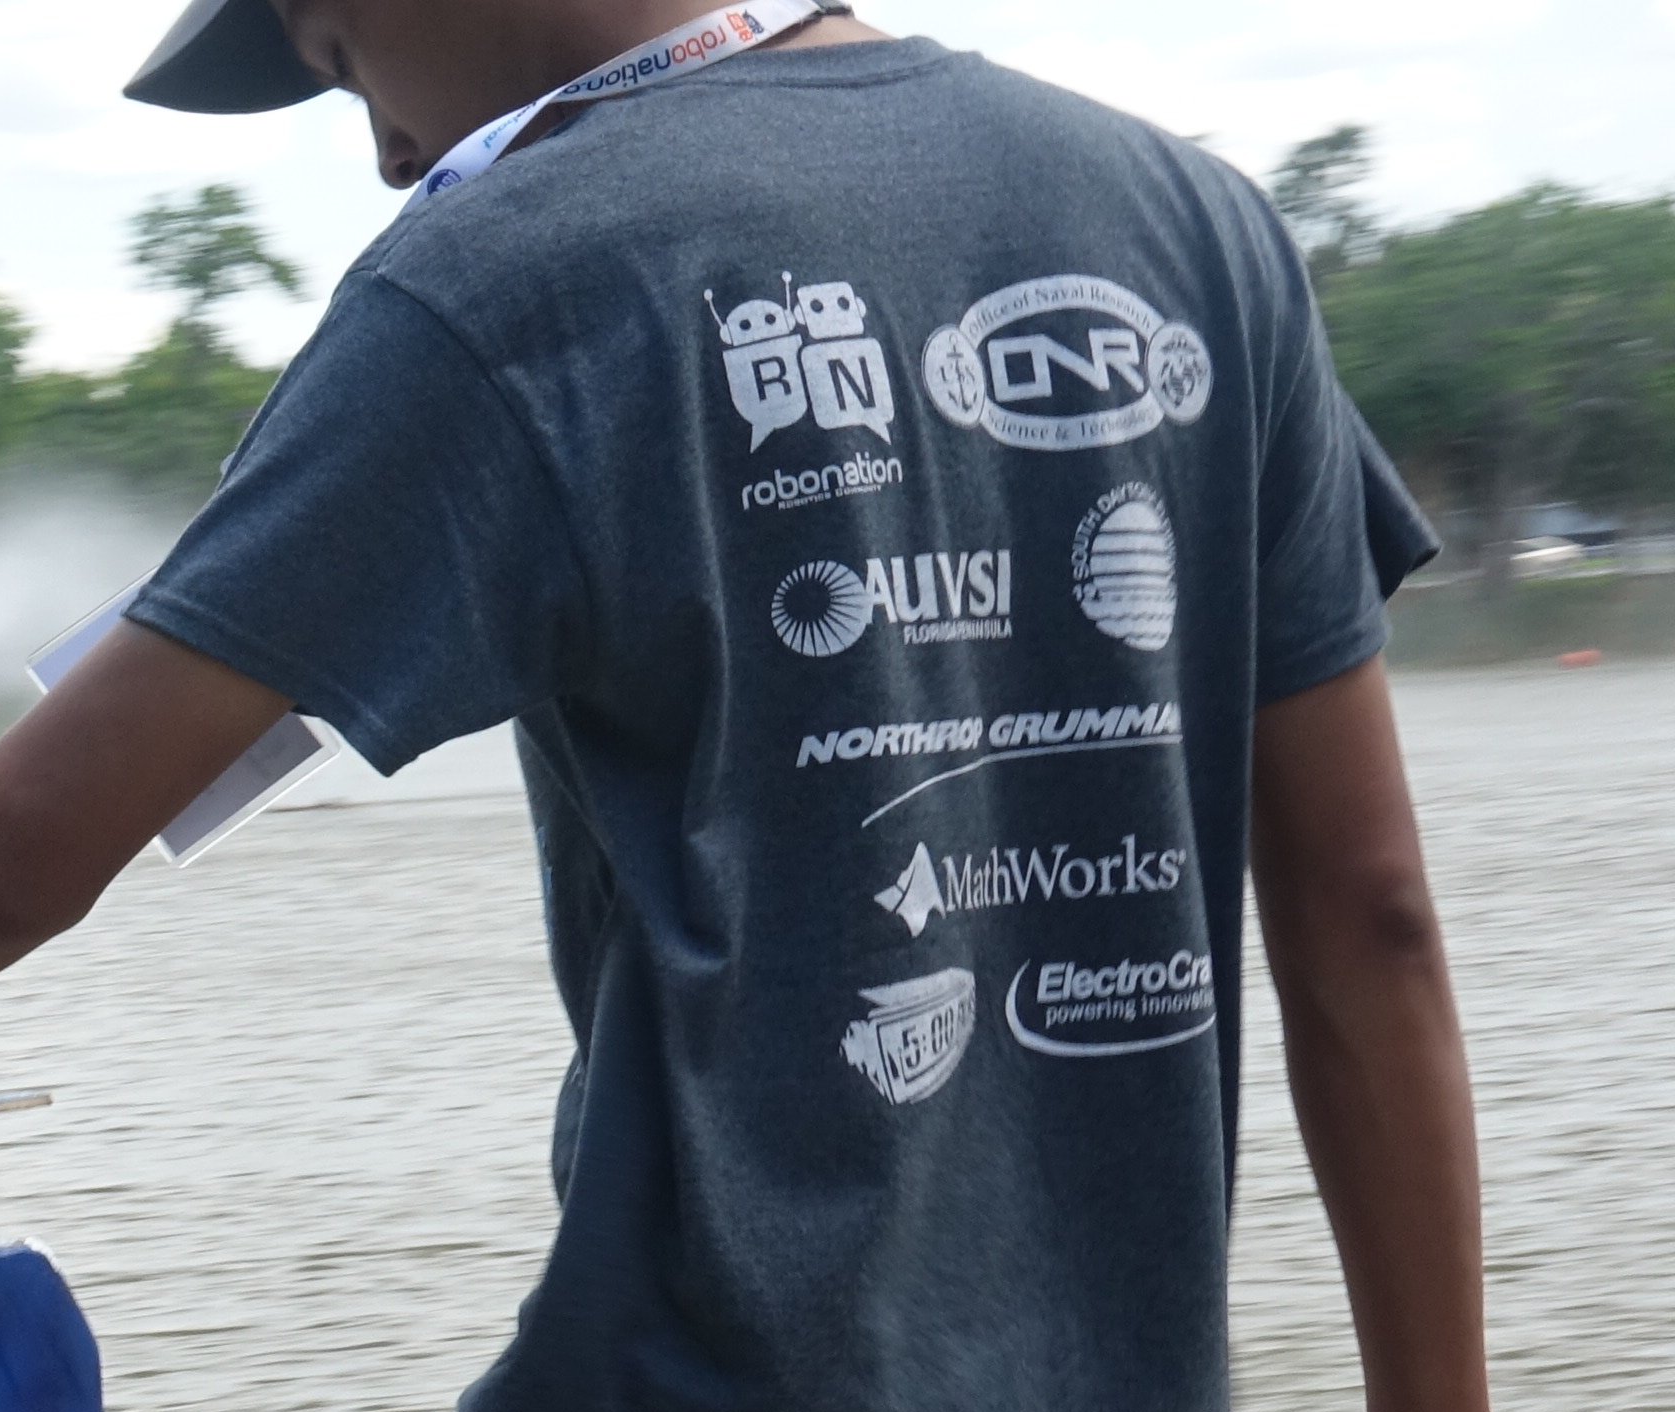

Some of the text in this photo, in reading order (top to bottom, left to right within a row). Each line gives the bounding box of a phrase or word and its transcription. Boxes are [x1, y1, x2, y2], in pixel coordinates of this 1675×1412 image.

[1012, 293, 1030, 311] of
[1034, 284, 1085, 304] Naval
[741, 451, 903, 510] robonation
[864, 549, 1011, 625] AUVSI
[795, 716, 983, 768] NORTHROP
[941, 833, 1181, 912] MathWorks
[1045, 997, 1136, 1030] powering
